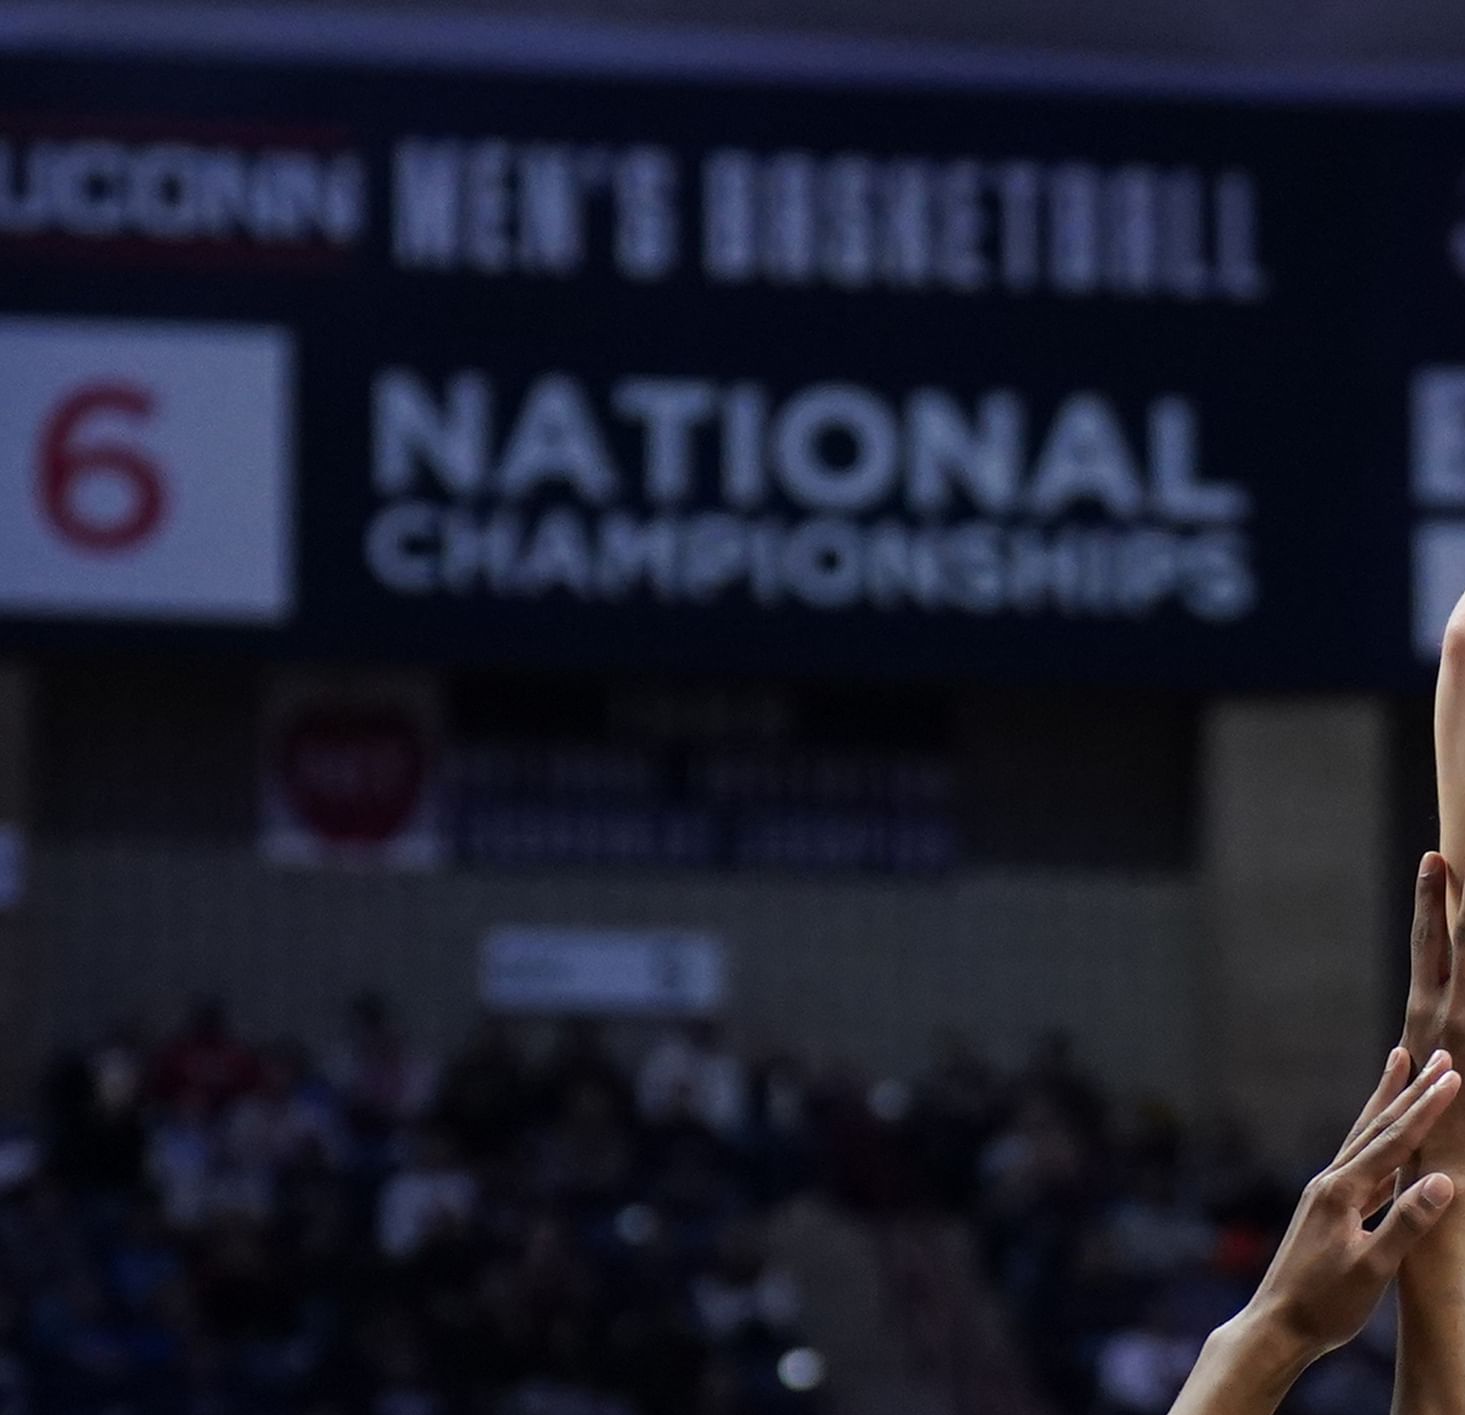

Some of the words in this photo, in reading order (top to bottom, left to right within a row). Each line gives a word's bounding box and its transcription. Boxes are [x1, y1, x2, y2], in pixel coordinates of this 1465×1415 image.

[0, 138, 364, 244] UCONN
[391, 136, 678, 281] MEN'S
[703, 147, 1262, 303] BASKETBALL
[34, 378, 170, 555] 6
[370, 368, 1248, 522] NATIONAL
[365, 502, 1256, 620] CHAMPIONSHIPS
